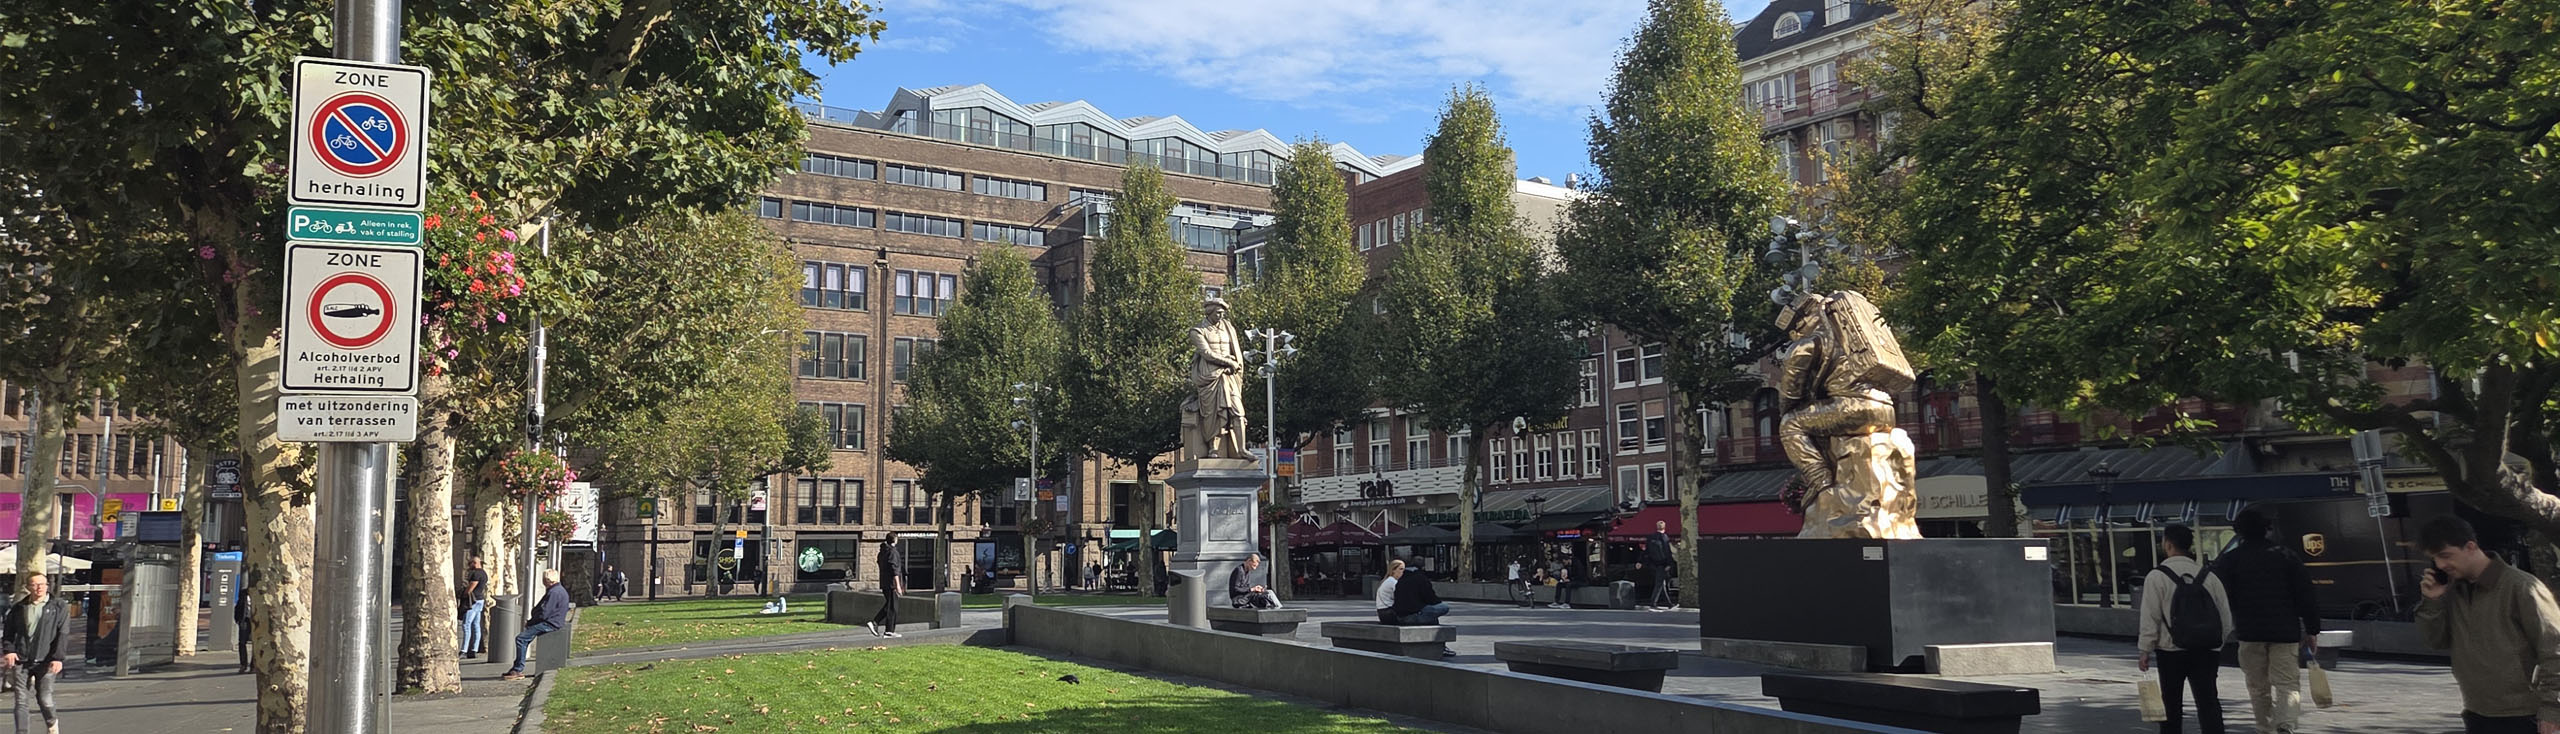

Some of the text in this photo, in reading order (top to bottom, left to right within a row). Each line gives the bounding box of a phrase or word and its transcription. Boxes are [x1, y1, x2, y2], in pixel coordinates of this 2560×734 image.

[335, 72, 389, 88] ZONE
[309, 180, 405, 201] herhaling
[294, 215, 310, 232] P
[360, 220, 386, 228] Alleen
[386, 230, 415, 239] stalling
[327, 253, 382, 268] ZONE
[299, 351, 400, 364] Alcoholverbod
[314, 373, 384, 387] Herhaling
[285, 401, 409, 414] met uitzondering
[297, 416, 396, 426] van terrassen
[1930, 495, 1988, 509] SCHILLE
